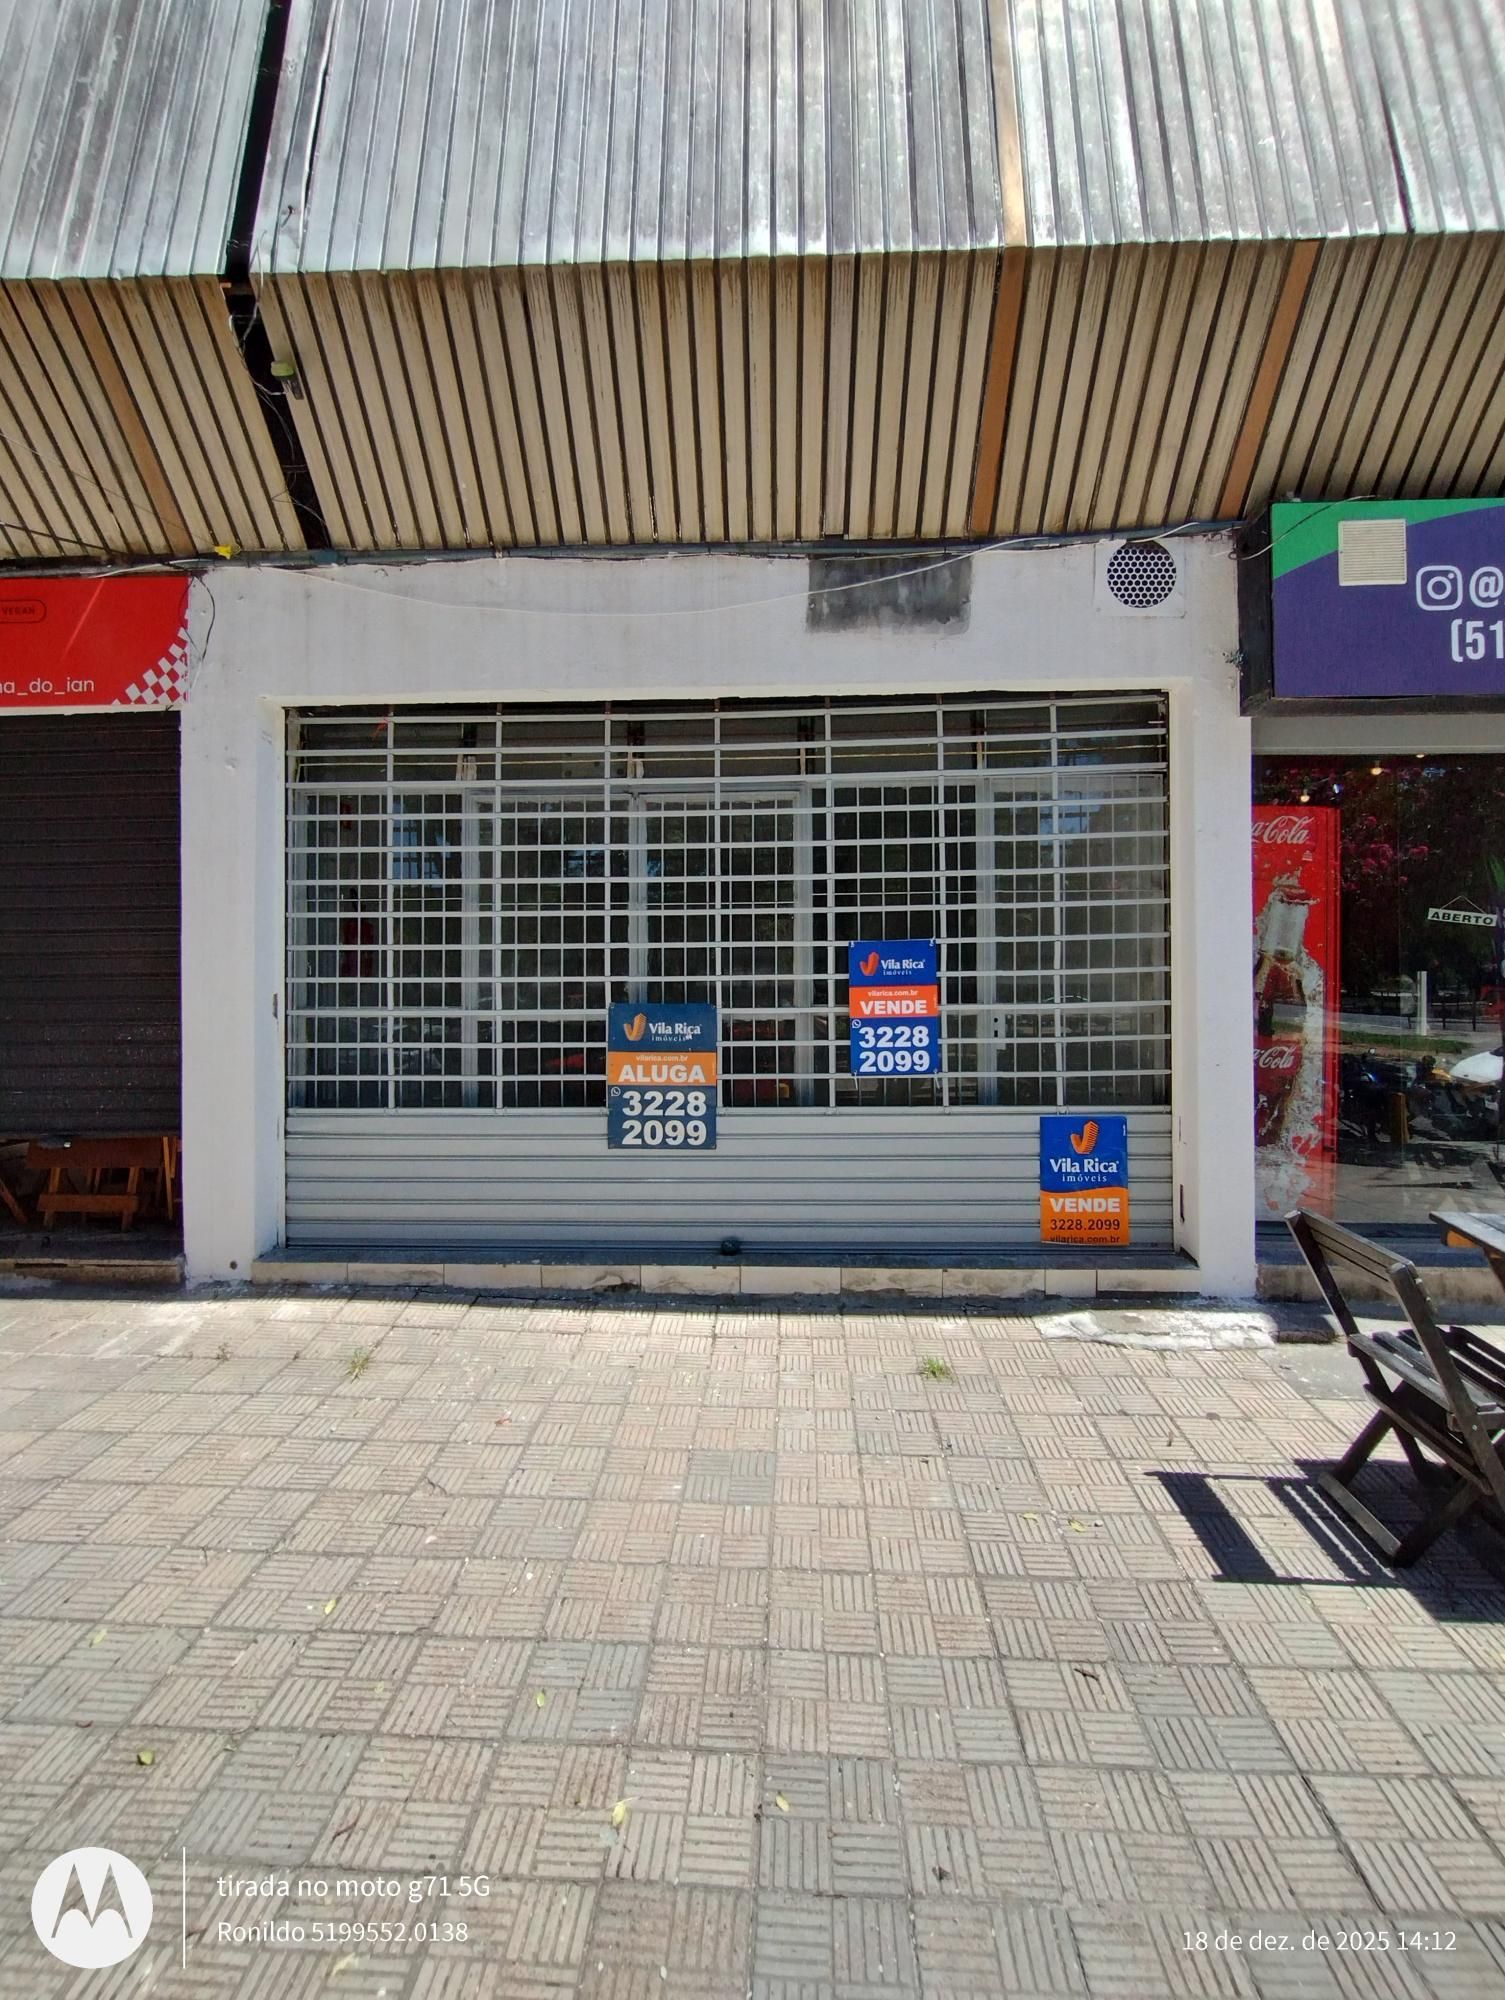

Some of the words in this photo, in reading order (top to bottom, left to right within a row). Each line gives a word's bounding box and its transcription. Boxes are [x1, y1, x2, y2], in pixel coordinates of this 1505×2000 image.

[1431, 912, 1494, 925] ABERTO
[881, 959, 900, 969] Vila
[902, 959, 925, 969] Rica
[860, 1000, 927, 1015] VENDE
[649, 1022, 673, 1034] Vila
[674, 1022, 701, 1035] Rica
[859, 1026, 930, 1048] 3228
[859, 1050, 930, 1073] 2099
[618, 1064, 706, 1083] ALUGA
[622, 1090, 707, 1117] 3228
[621, 1119, 707, 1146] 2099
[1050, 1158, 1080, 1173] Vila
[1084, 1158, 1118, 1173] Rica
[1062, 1174, 1107, 1182] imóveis
[1049, 1198, 1120, 1213] VENDE
[1050, 1218, 1120, 1231] 3228.2099
[1050, 1235, 1120, 1244] vilarica.com.br
